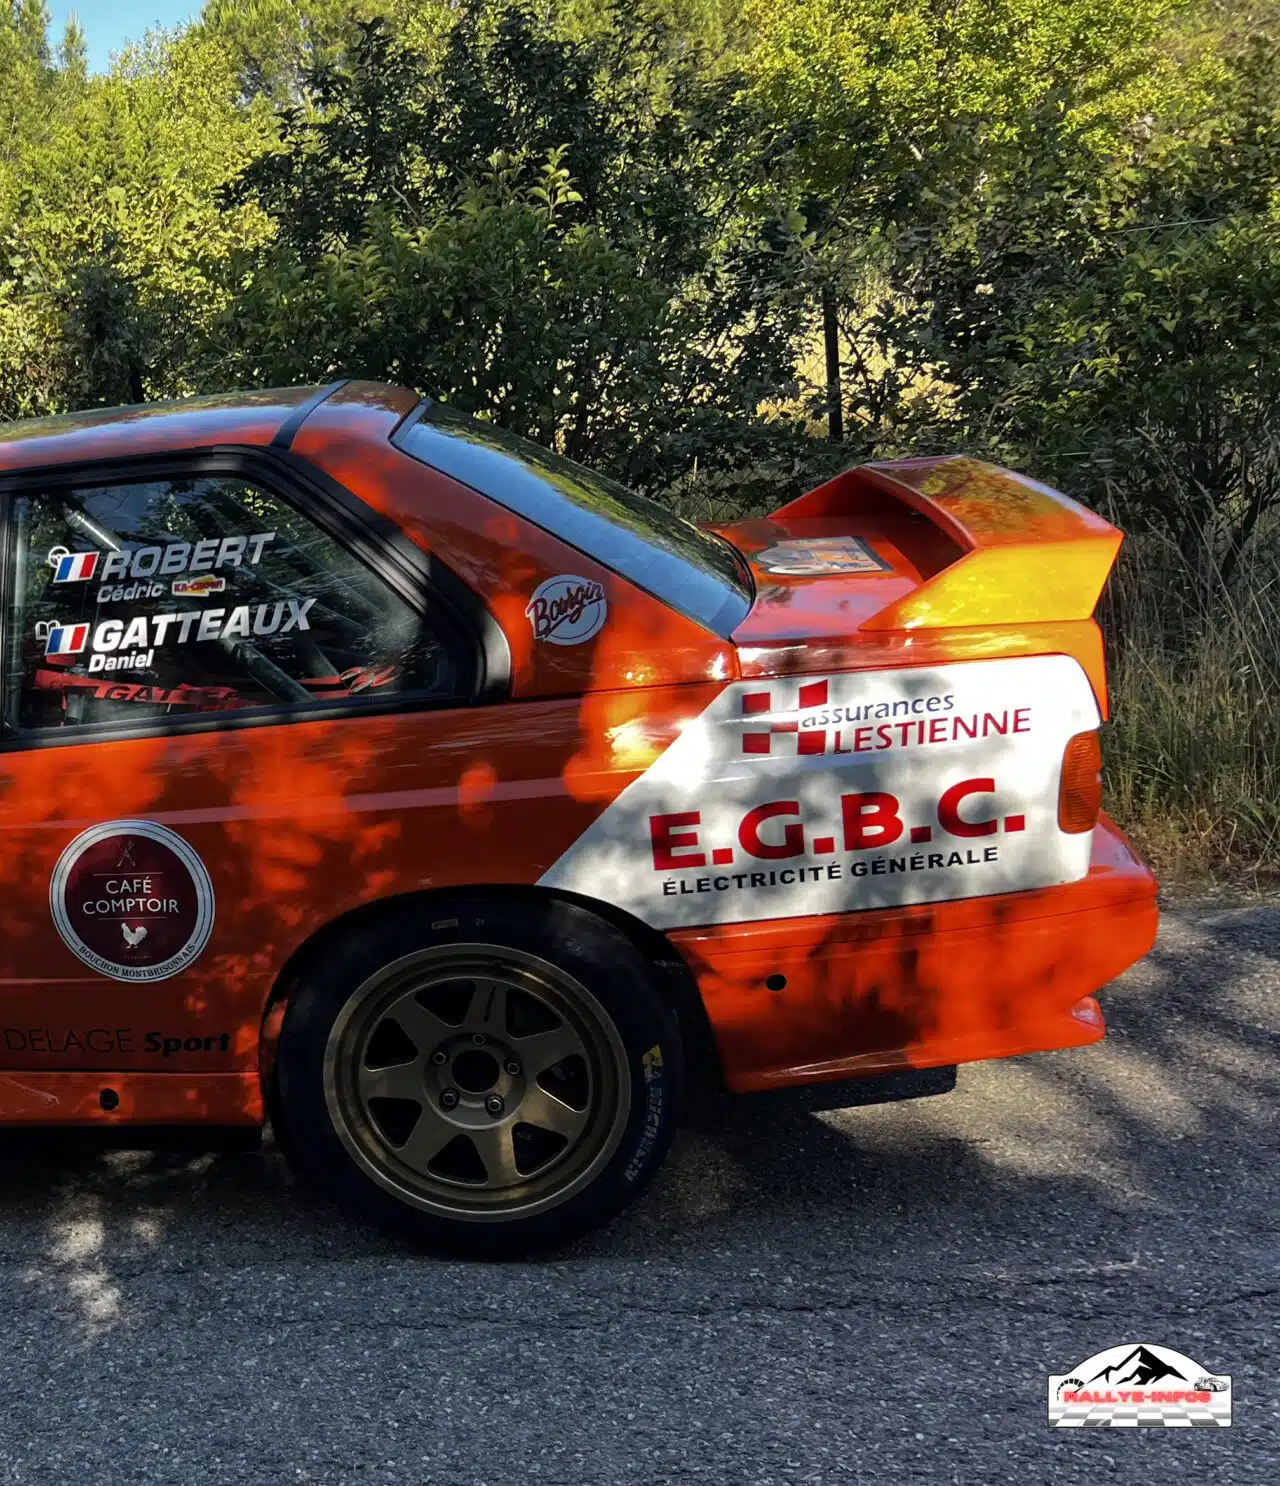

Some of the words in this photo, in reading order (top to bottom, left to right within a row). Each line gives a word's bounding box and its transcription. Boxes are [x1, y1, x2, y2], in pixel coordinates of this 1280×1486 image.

[102, 532, 275, 581] ROBERT
[96, 581, 164, 603] Cédric
[92, 598, 318, 652] GATTEAUX
[88, 649, 154, 673] Daniel
[801, 694, 955, 728] assurances
[834, 707, 1032, 754] LESTIENNE
[649, 778, 1026, 871] E.G.B.C.
[105, 876, 153, 895] CAFÉ
[663, 860, 842, 896] ÉLECTRICITÉ
[850, 846, 999, 878] GÉNÉRALE
[82, 897, 180, 916] COMPTOIR
[80, 944, 120, 975] BOUCHON
[120, 943, 195, 978] MONTBRISONNAIS
[3, 1028, 136, 1054] DELAGE
[144, 1031, 232, 1057] Sport
